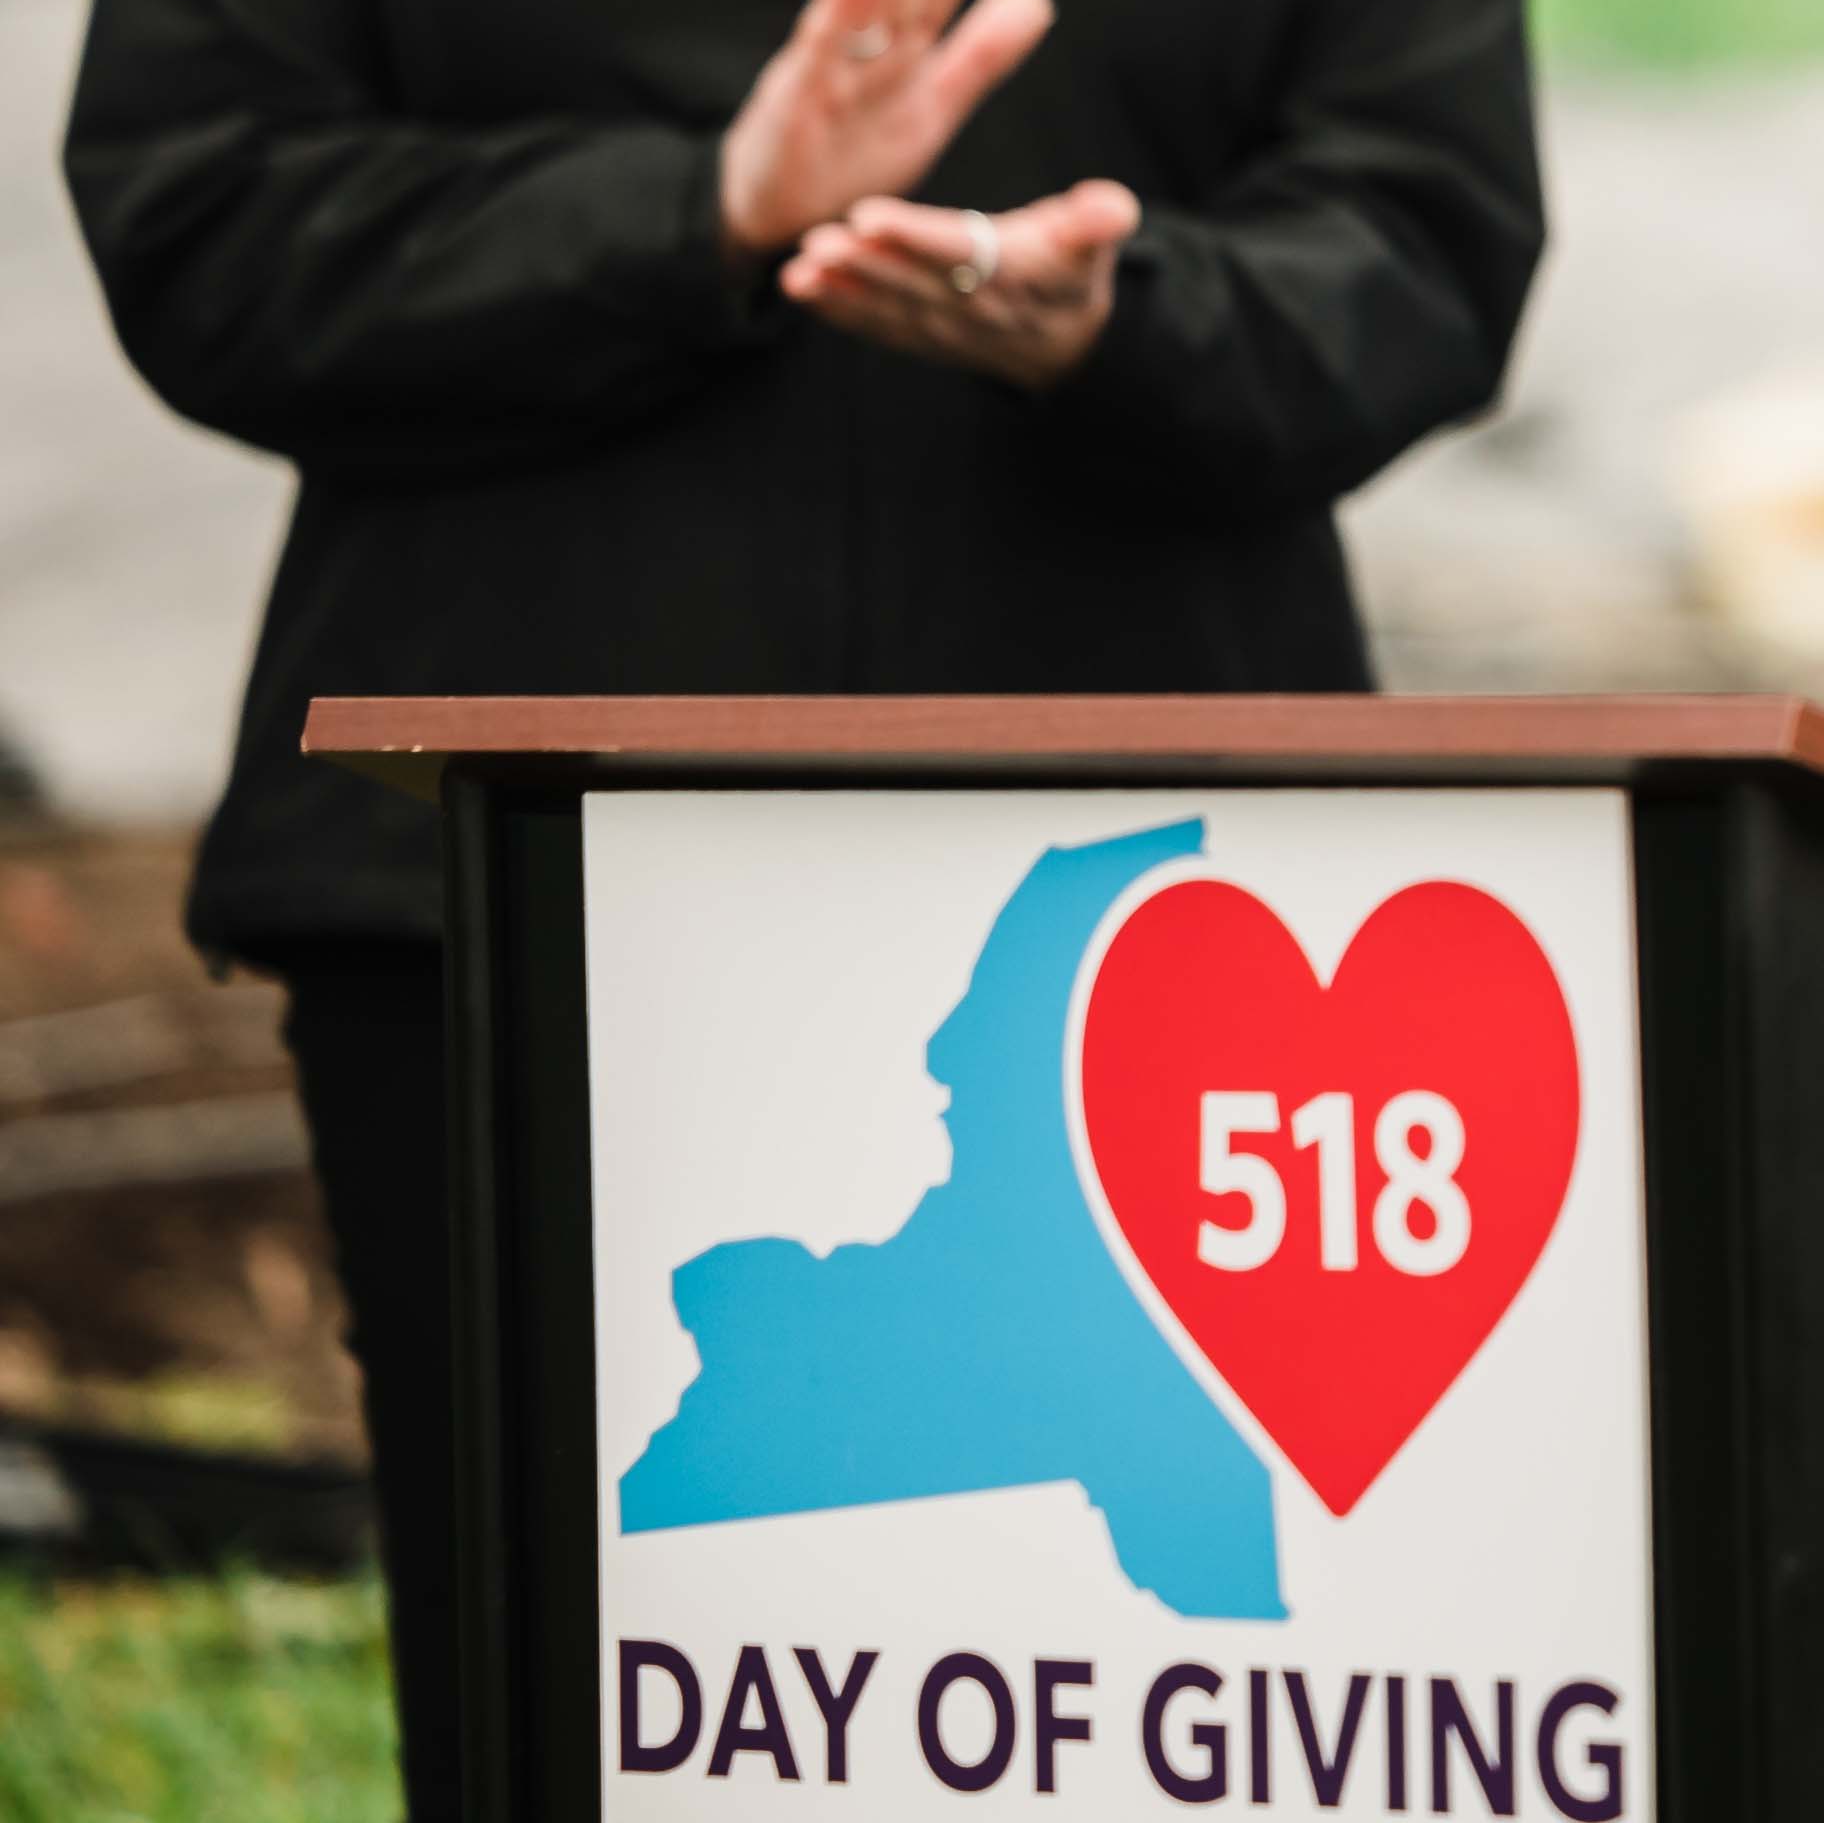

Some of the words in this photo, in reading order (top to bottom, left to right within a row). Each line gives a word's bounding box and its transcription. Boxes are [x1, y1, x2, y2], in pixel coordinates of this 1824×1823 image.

[1197, 1089, 1473, 1277] 518
[617, 1638, 881, 1785] DAY
[917, 1651, 1097, 1795] OF
[1141, 1662, 1625, 1823] GIVING
